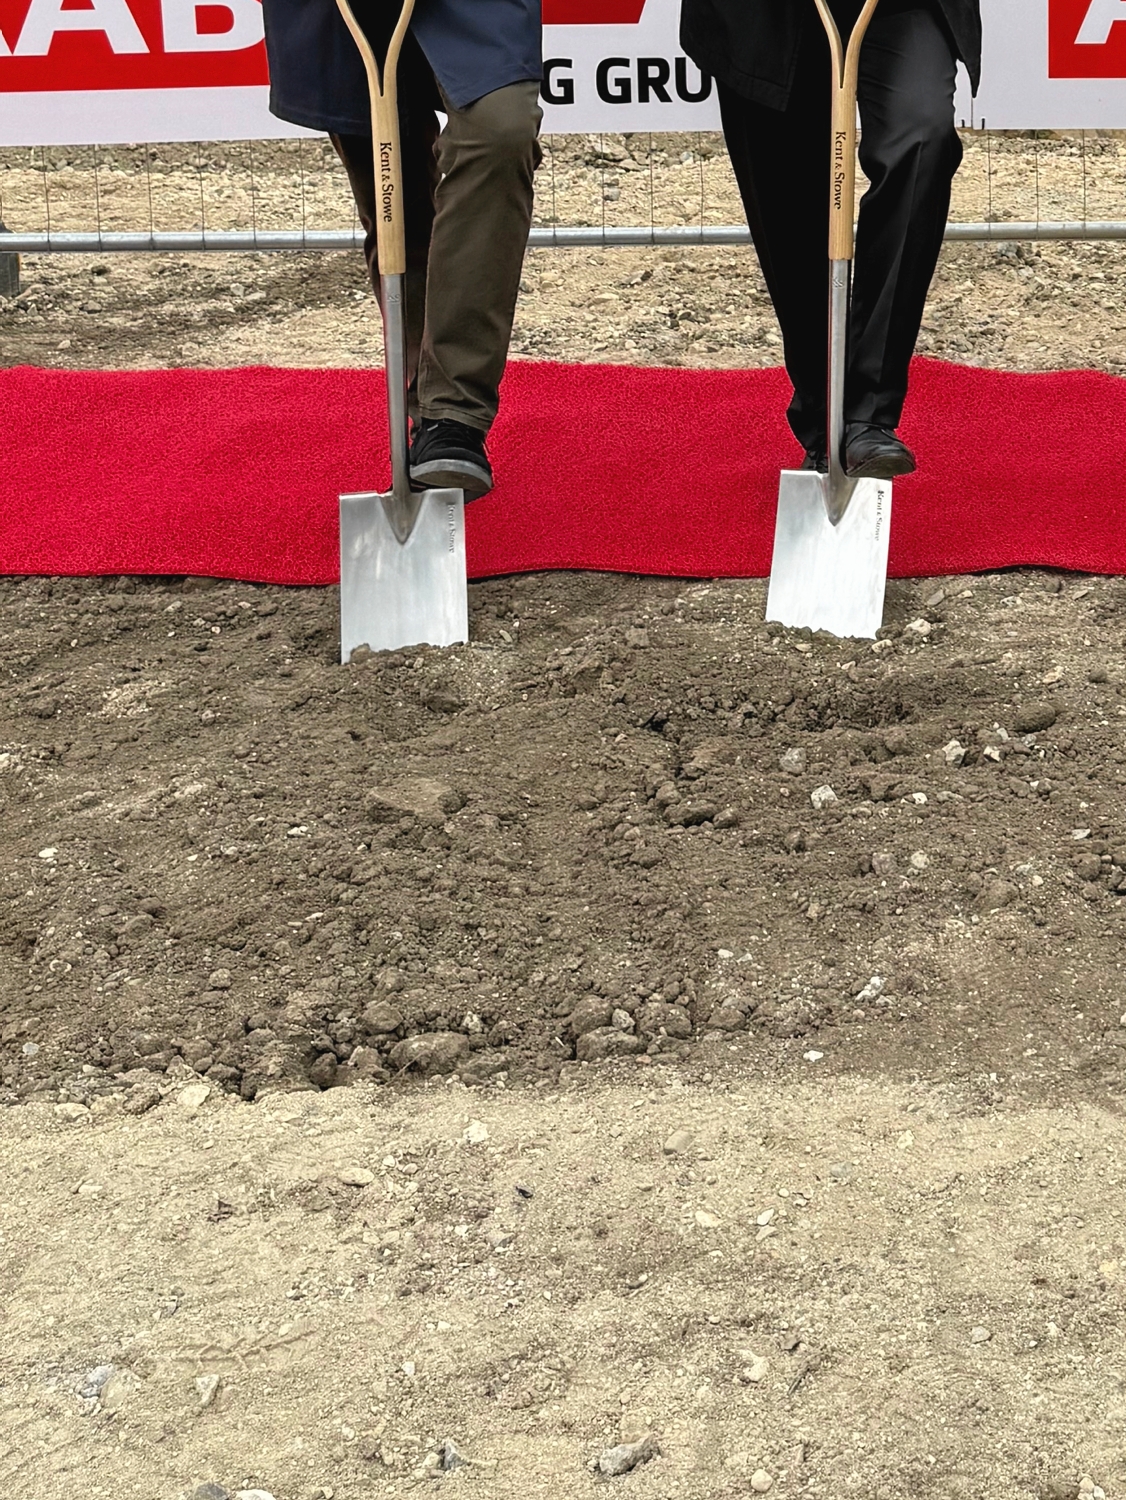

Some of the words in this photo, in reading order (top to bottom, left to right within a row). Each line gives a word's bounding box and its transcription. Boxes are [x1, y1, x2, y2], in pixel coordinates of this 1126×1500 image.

[380, 142, 392, 173] Kent
[835, 131, 847, 160] Kent
[381, 173, 391, 183] &
[834, 171, 846, 210] Stowe
[382, 183, 394, 223] Stowe
